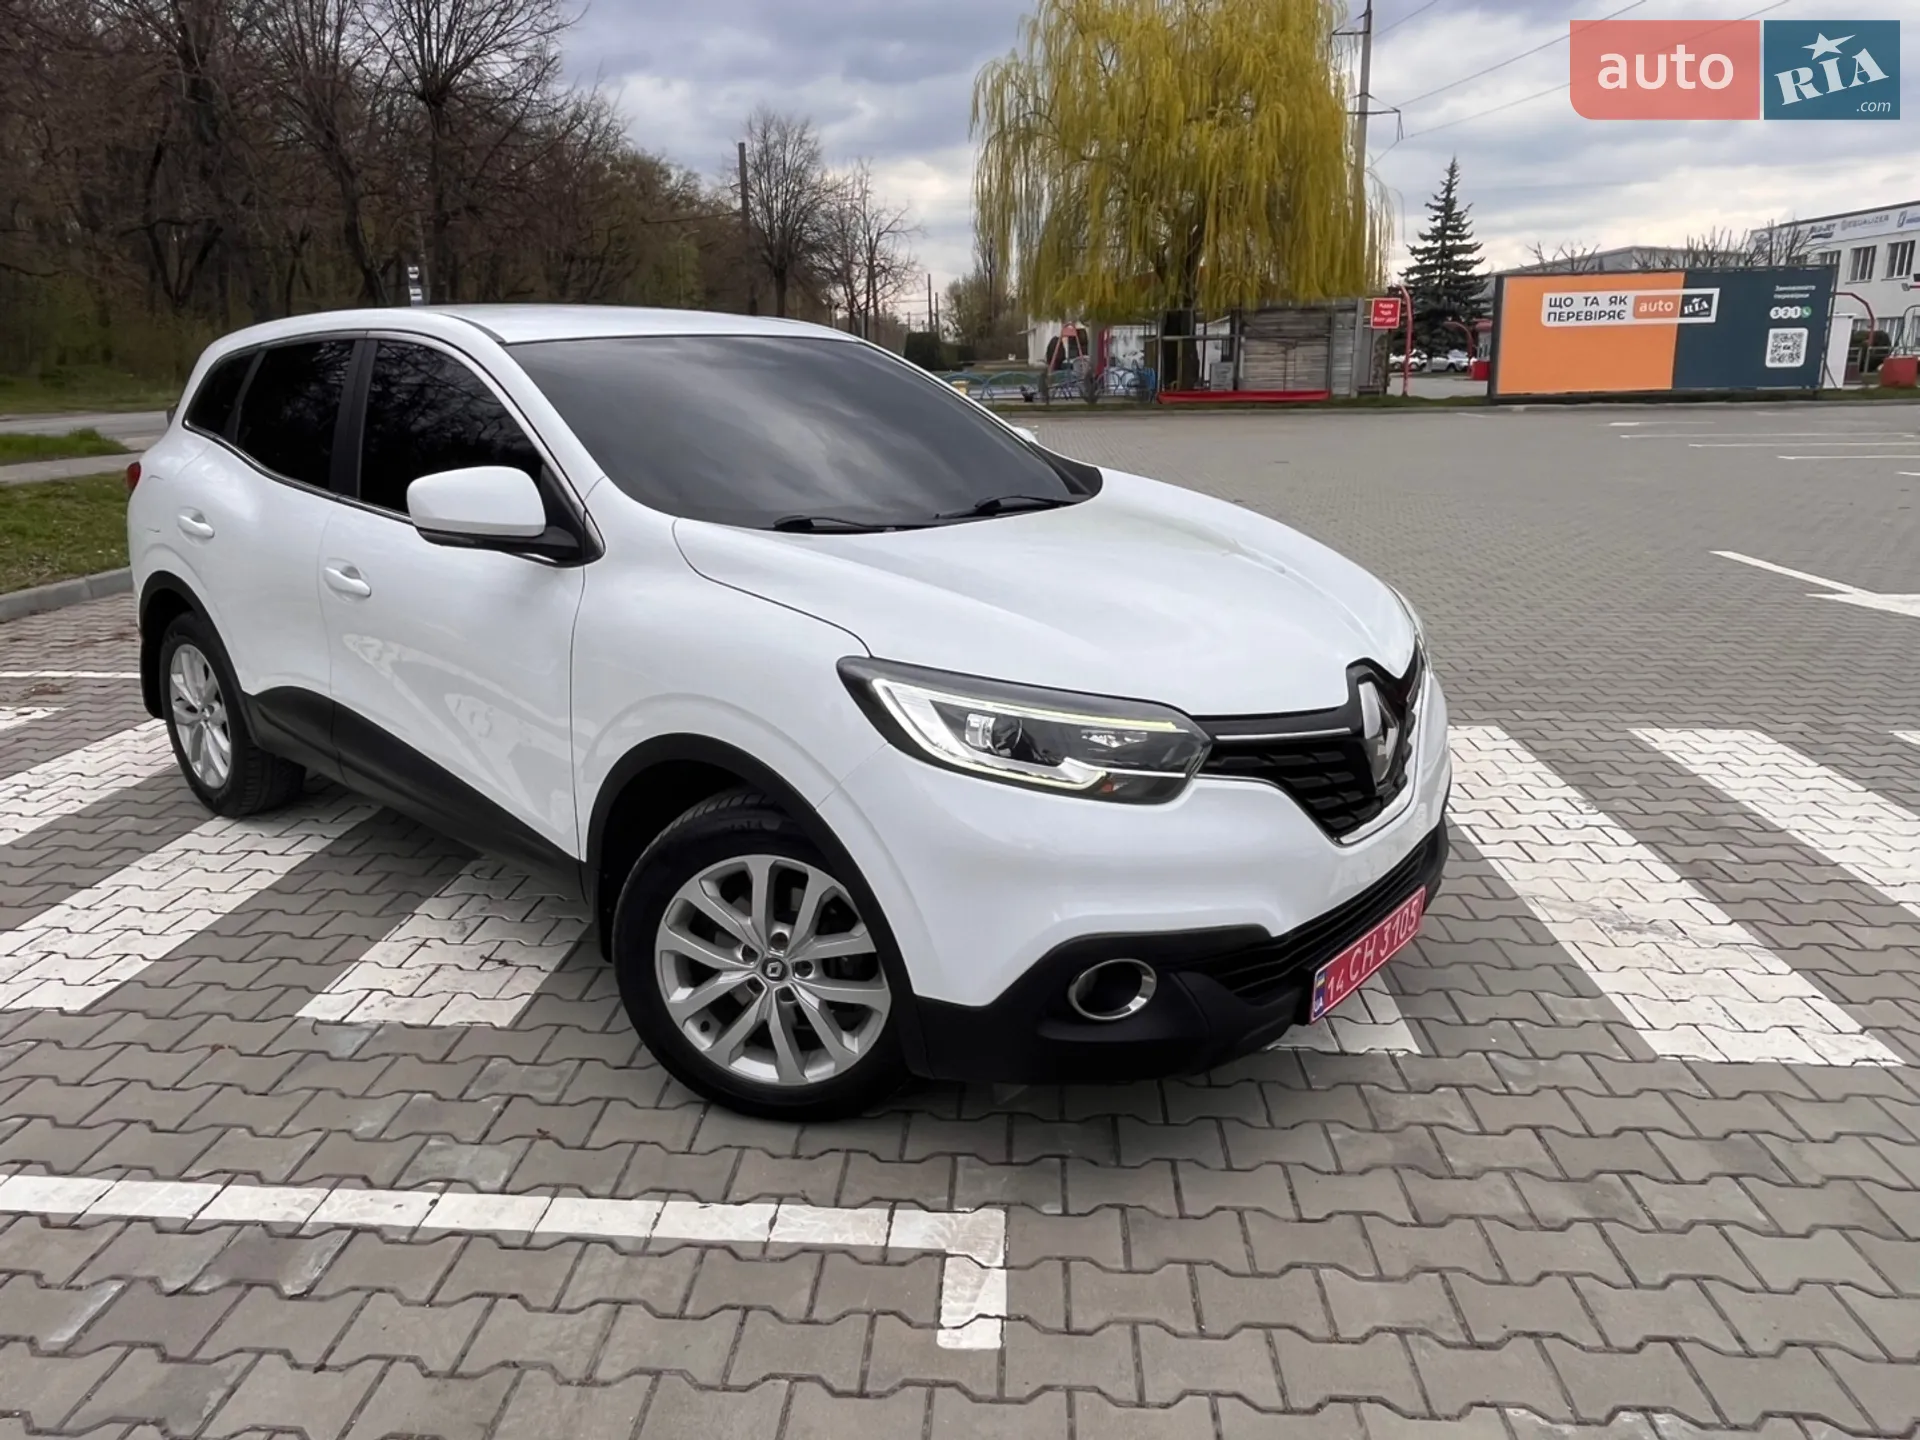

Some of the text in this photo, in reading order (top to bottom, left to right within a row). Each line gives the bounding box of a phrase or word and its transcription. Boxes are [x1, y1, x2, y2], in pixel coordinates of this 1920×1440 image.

[1549, 295, 1628, 309] ЩО ТА ЯК
[1639, 300, 1709, 315] auto RIA
[1547, 309, 1626, 322] ПЕРЕВІРЯЄ
[1328, 899, 1420, 1001] 14 CH 3105
